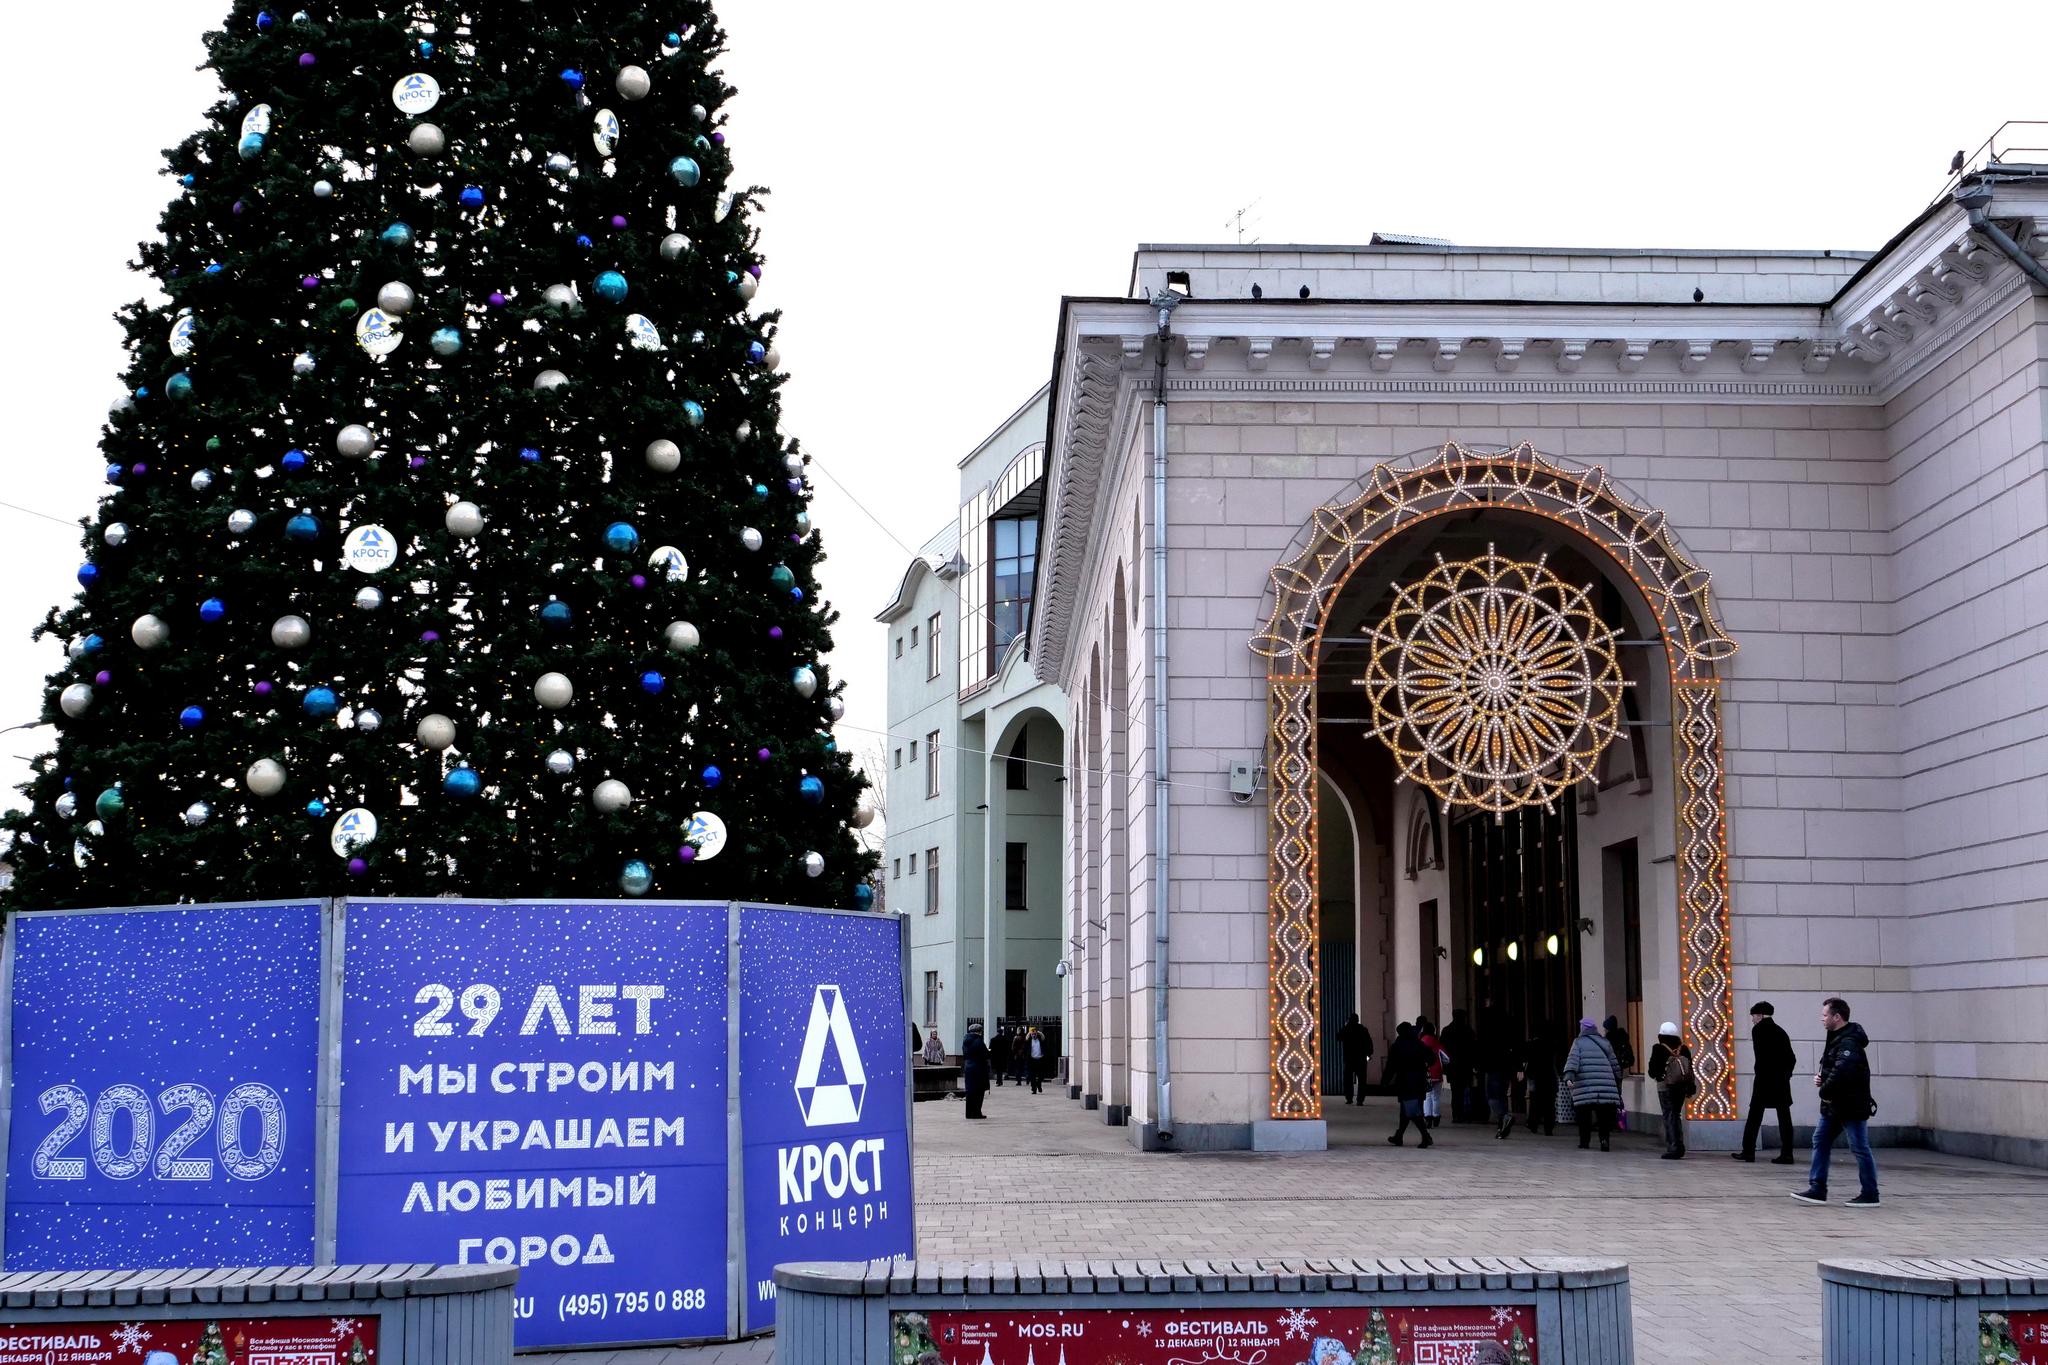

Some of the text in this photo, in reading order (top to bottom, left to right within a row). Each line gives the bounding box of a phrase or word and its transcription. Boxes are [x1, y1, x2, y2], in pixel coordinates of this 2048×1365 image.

[399, 90, 432, 101] КРОСТ
[635, 334, 659, 346] КРОС
[353, 549, 389, 558] КРОСТ
[691, 832, 718, 845] РОСТ
[413, 983, 665, 1037] 29 ЛЕТ
[399, 1061, 675, 1095] МЫ СТРОИМ
[32, 1083, 287, 1181] 2020
[385, 1116, 685, 1153] И УКРАШАЕМ
[778, 1137, 885, 1206] КРОСТ
[401, 1171, 657, 1213] ЛЮБИМЫЙ
[780, 1200, 888, 1237] концерн
[458, 1233, 615, 1267] ГОРОД
[559, 1294, 608, 1322] (495)
[614, 1291, 649, 1313] 795
[654, 1290, 666, 1312] 0
[671, 1288, 706, 1311] 888
[961, 1324, 978, 1332] Проект
[1018, 1323, 1084, 1338] MOS.RU
[1164, 1321, 1269, 1336] ФЕСТИВАЛЬ
[1155, 1338, 1280, 1348] 13 ДЕКАБРЯ 12 ЯНВАРЯ
[58, 1353, 69, 1362] 12
[71, 1352, 113, 1361] ЯНВАРЯ
